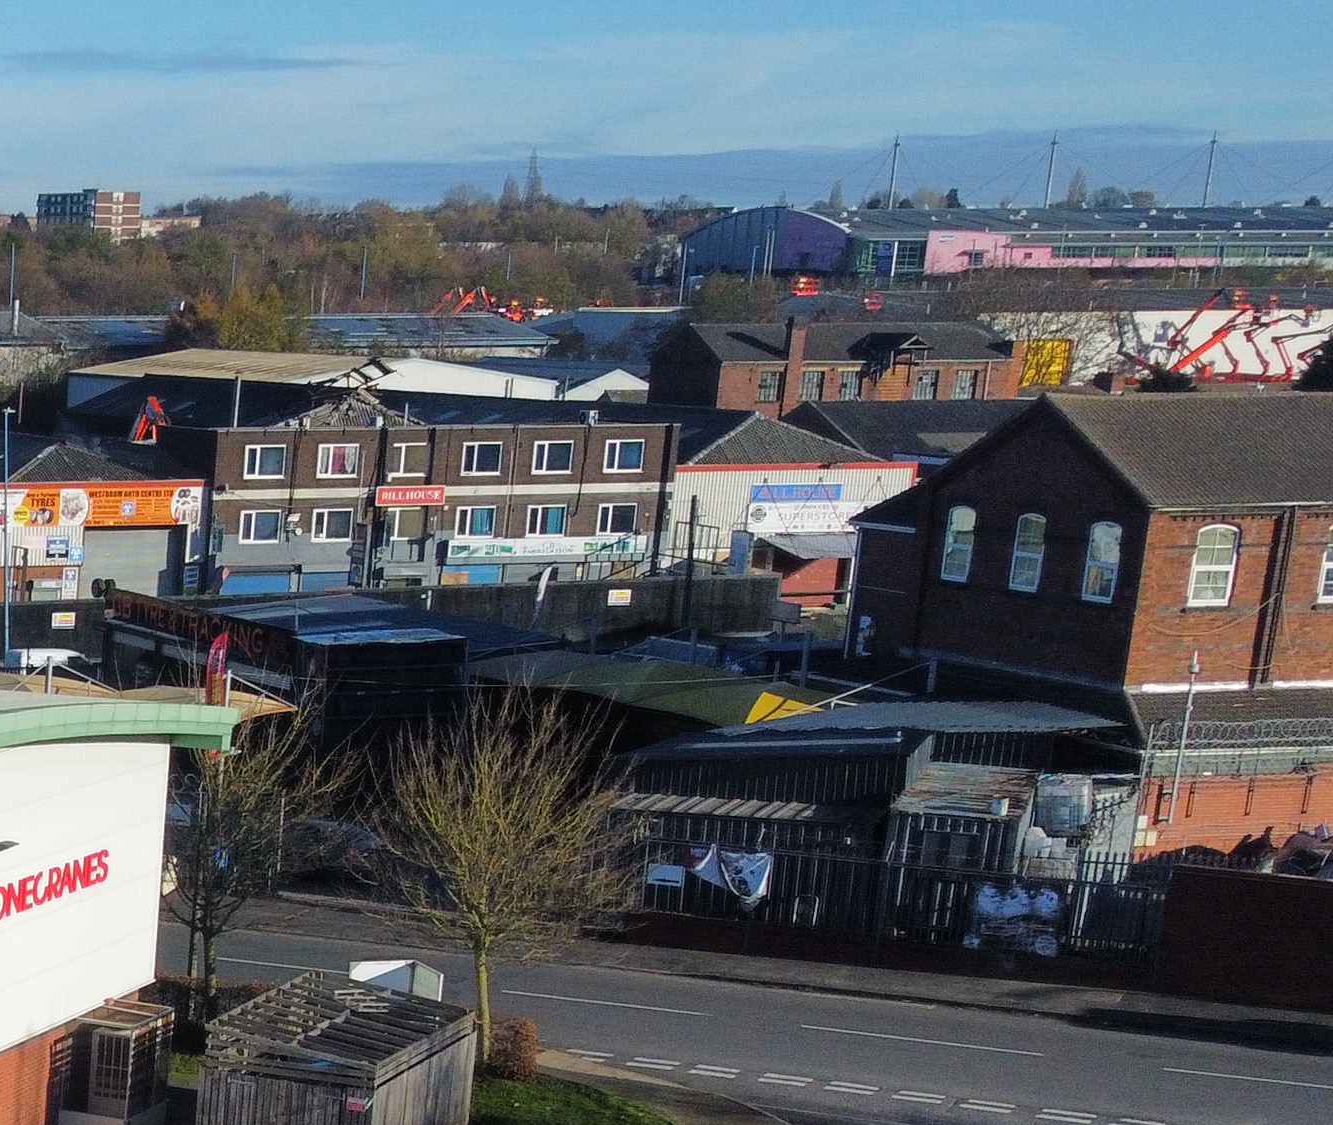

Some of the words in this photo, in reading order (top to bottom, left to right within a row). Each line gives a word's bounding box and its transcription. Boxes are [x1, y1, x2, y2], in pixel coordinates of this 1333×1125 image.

[382, 491, 404, 500] BILL
[406, 490, 441, 500] HOUSE
[31, 498, 56, 507] TYRES
[136, 601, 165, 627] TYRE
[178, 612, 264, 655] TRACKING
